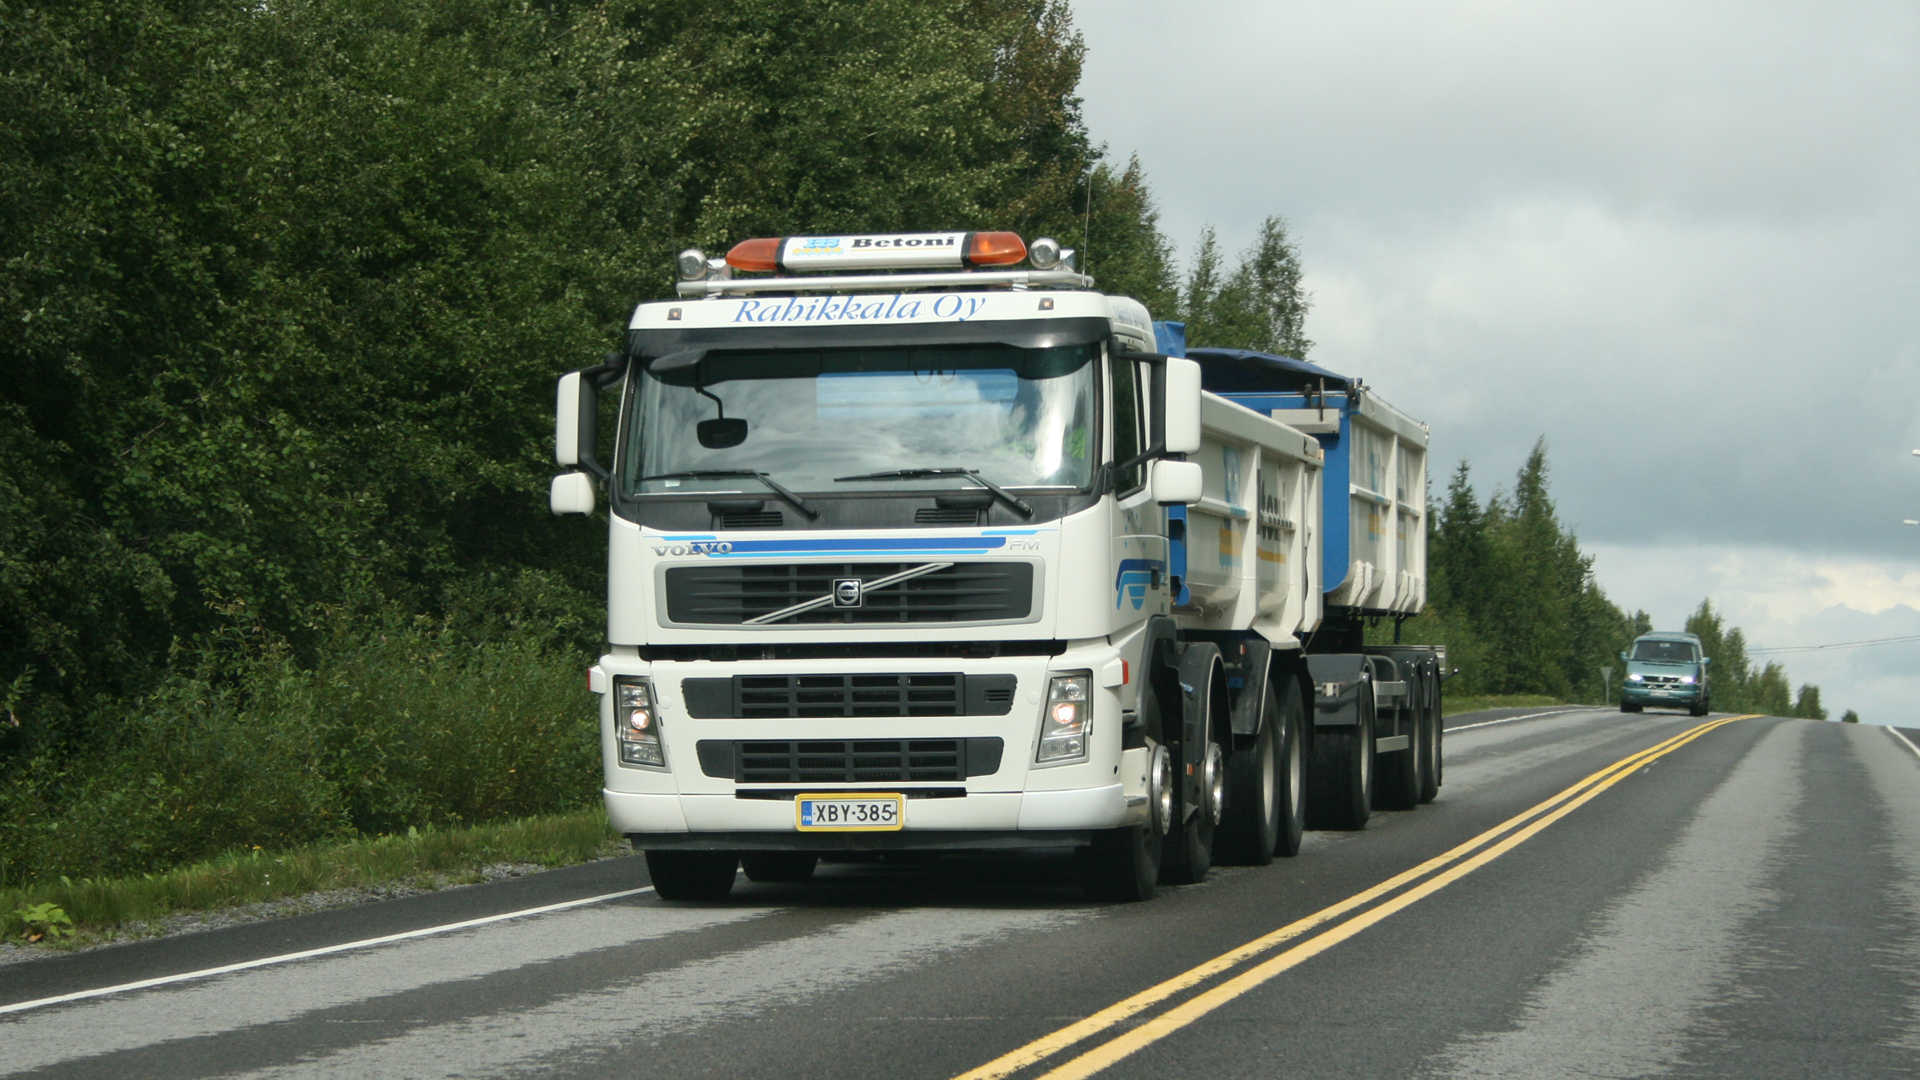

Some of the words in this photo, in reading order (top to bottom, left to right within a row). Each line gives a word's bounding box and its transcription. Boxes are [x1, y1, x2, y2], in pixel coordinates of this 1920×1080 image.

[851, 236, 955, 248] Betoni
[731, 294, 922, 323] Rahikkala
[933, 294, 986, 321] Oy
[651, 542, 733, 557] VOLVO
[1010, 539, 1041, 550] FM
[816, 804, 893, 822] XBY-385
